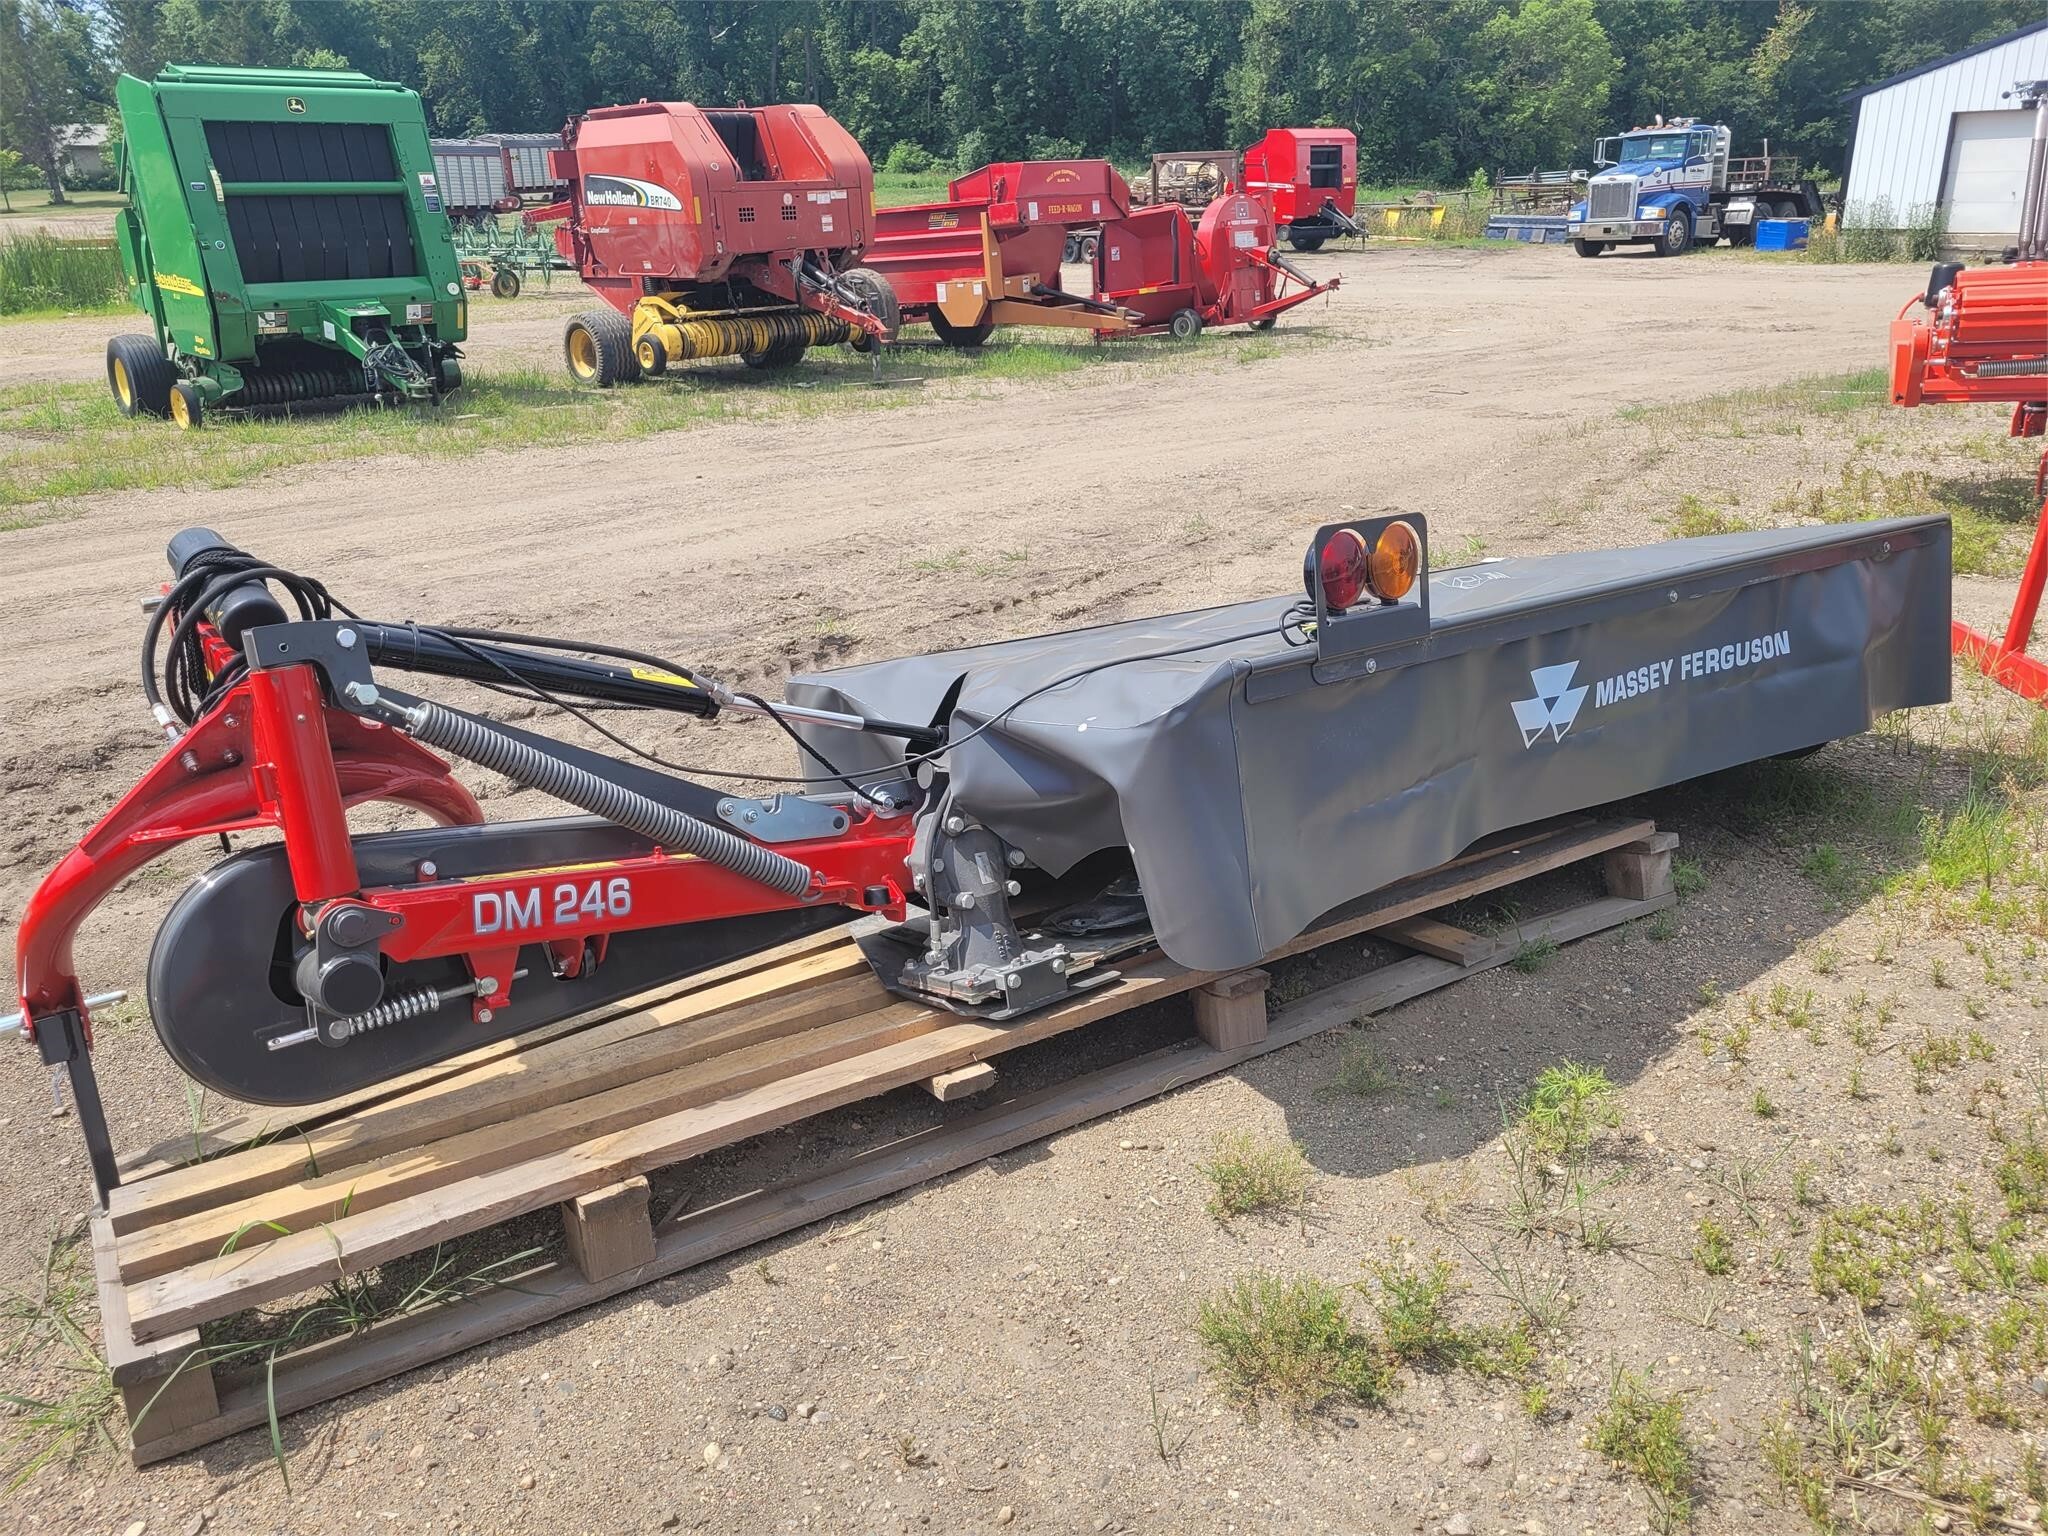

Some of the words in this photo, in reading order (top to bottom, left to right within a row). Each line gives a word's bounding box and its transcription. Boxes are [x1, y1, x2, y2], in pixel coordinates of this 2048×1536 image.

[650, 195, 672, 207] BR740
[1595, 658, 1674, 708] MASSEY
[1680, 630, 1791, 681] FERGUSON
[473, 887, 543, 935] DM
[553, 877, 632, 925] 246
